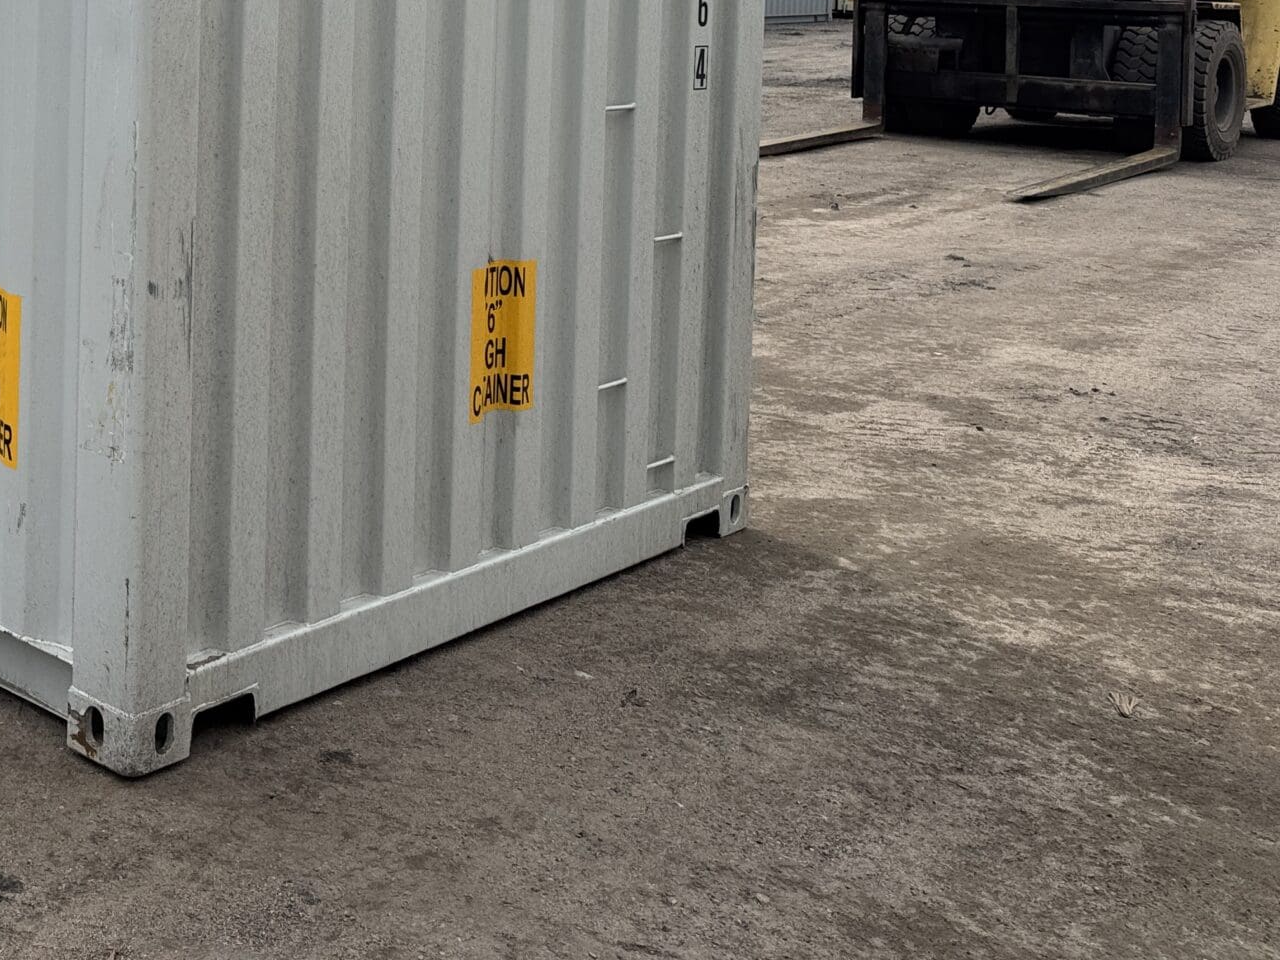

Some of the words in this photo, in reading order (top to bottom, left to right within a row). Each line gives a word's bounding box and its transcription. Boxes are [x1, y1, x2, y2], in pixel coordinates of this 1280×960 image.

[694, 47, 707, 89] 4
[484, 265, 526, 298] TION
[484, 337, 506, 370] GH
[472, 373, 530, 417] CAINER
